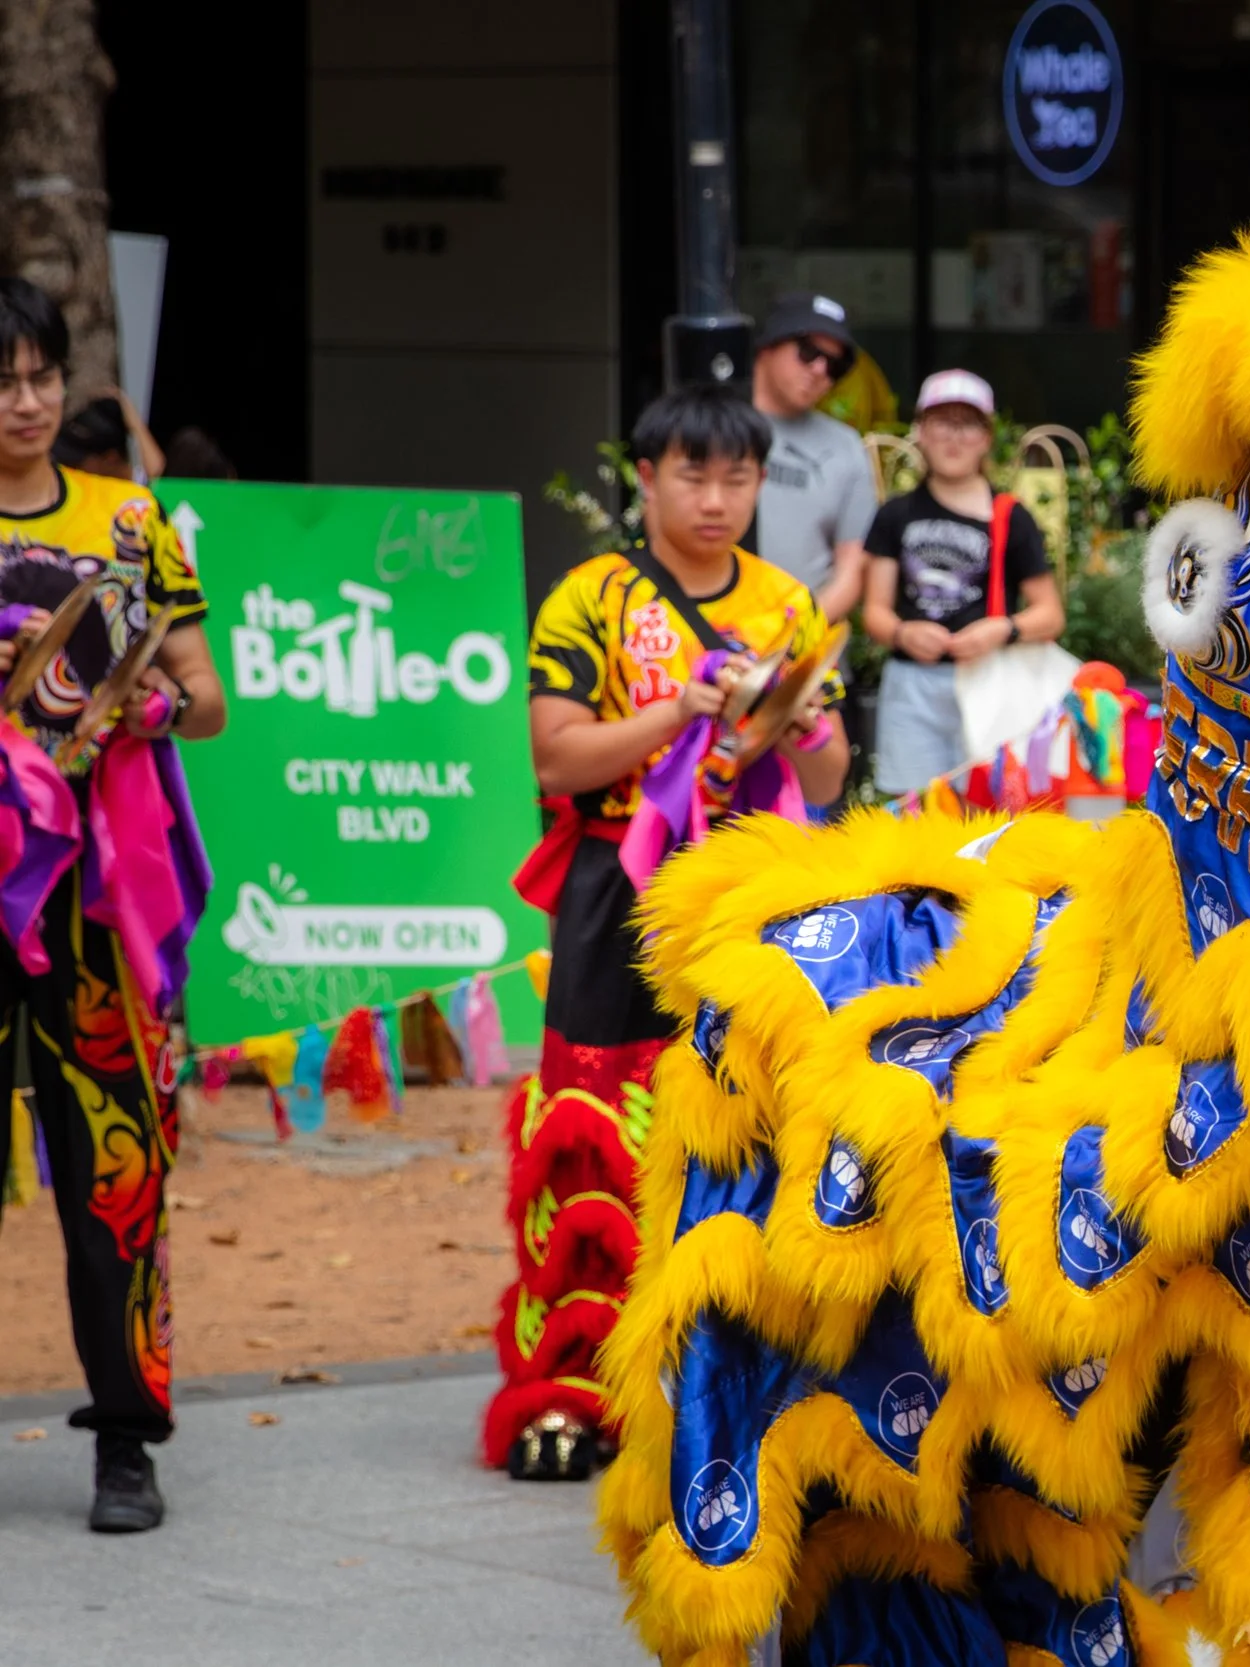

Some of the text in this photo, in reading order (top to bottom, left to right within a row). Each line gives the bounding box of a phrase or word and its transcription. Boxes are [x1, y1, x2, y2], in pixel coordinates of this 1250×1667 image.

[242, 583, 315, 631] the
[285, 758, 476, 797] CITY WALK
[337, 805, 430, 842] BLVD
[305, 921, 481, 951] NOW OPEN
[816, 913, 840, 951] WE ARE
[890, 1391, 926, 1412] WE ARE
[696, 1490, 714, 1507] WE
